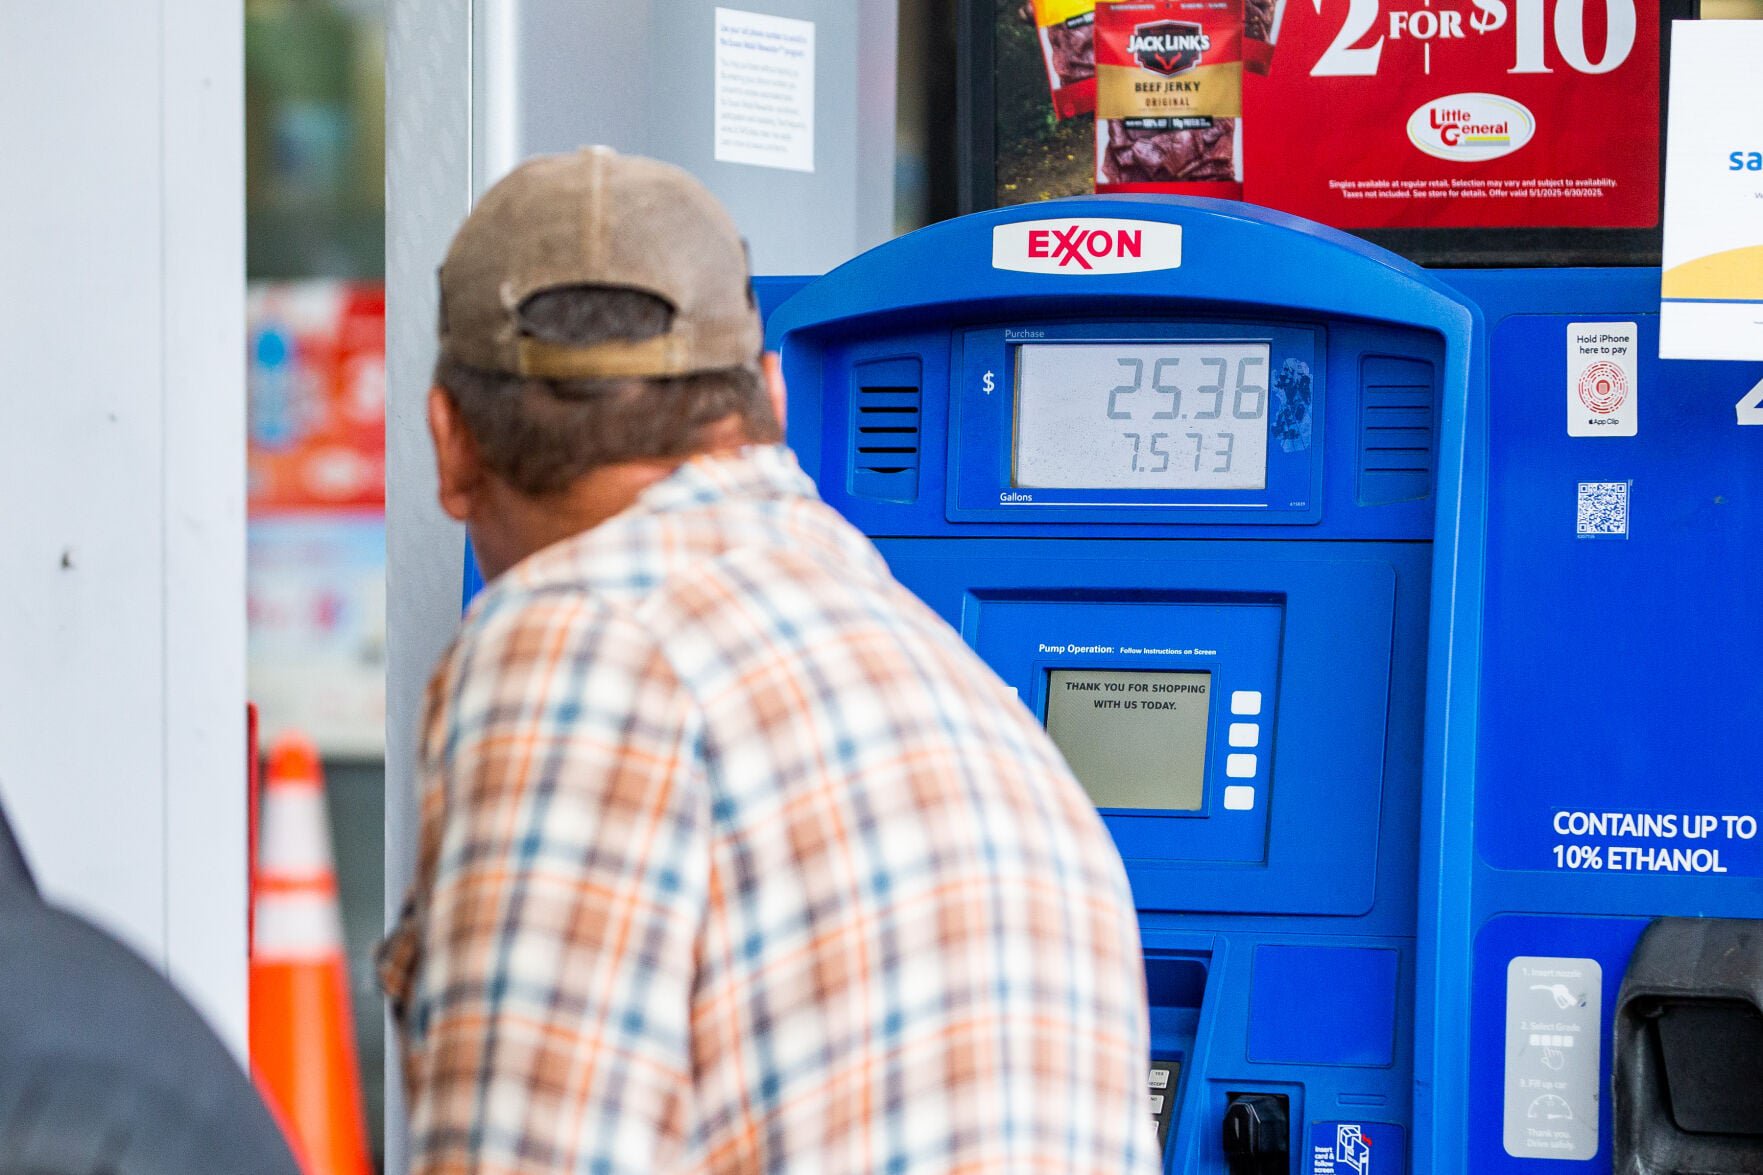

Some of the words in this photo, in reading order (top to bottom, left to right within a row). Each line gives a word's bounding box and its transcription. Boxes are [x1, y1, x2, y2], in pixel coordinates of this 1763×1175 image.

[1127, 35, 1165, 53] JACK
[1306, 0, 1384, 76] 2
[1389, 11, 1465, 39] FOR
[1135, 82, 1161, 92] BEEF
[1165, 81, 1201, 93] JERKY
[1145, 97, 1190, 106] ORIGINAL
[1429, 108, 1471, 129] Little
[1440, 121, 1508, 147] General
[1729, 151, 1763, 171] sa
[1328, 180, 1356, 190] Singles
[1357, 179, 1390, 188] available
[1391, 180, 1399, 188] at
[1400, 179, 1427, 189] regular
[1451, 178, 1486, 188] Selection
[1487, 180, 1502, 189] may
[1503, 180, 1520, 189] vary
[1521, 179, 1536, 187] and
[1537, 179, 1564, 189] subject
[1565, 179, 1574, 187] to
[1575, 178, 1618, 188] availability.
[1342, 190, 1363, 198] Taxes
[1364, 190, 1377, 198] not
[1378, 190, 1411, 198] included.
[1412, 189, 1427, 198] See
[1428, 190, 1447, 198] store
[1448, 189, 1459, 197] for
[1460, 189, 1487, 197] details.
[1488, 189, 1508, 197] Offer
[1509, 189, 1528, 197] valid
[1028, 225, 1143, 270] EXXON
[1005, 329, 1045, 339] Purchase
[1576, 334, 1597, 343] Hold
[1599, 334, 1630, 343] iPhone
[1579, 345, 1599, 354] here
[1600, 346, 1610, 354] to
[1612, 347, 1627, 355] pay
[982, 370, 995, 395] $
[1106, 357, 1266, 420] 25.36
[1593, 418, 1606, 426] App
[1122, 432, 1235, 473] 7.573
[1000, 492, 1033, 502] Gallons
[1038, 644, 1065, 654] Pump
[1067, 644, 1115, 655] Operation:
[1120, 647, 1142, 655] Follow
[1143, 648, 1182, 656] Instructions
[1066, 682, 1101, 691] THANK
[1104, 682, 1125, 692] YOU
[1128, 683, 1149, 693] FOR
[1152, 684, 1206, 694] SHOPPING
[1094, 700, 1121, 709] WITH
[1124, 700, 1138, 710] US
[1141, 701, 1177, 711] TODAY.
[1553, 811, 1677, 838] CONTAINS
[1683, 814, 1718, 839] UP
[1722, 815, 1757, 839] TO
[1553, 844, 1603, 870] 10%
[1607, 846, 1727, 872] ETHANOL
[1314, 1159, 1334, 1167] follow
